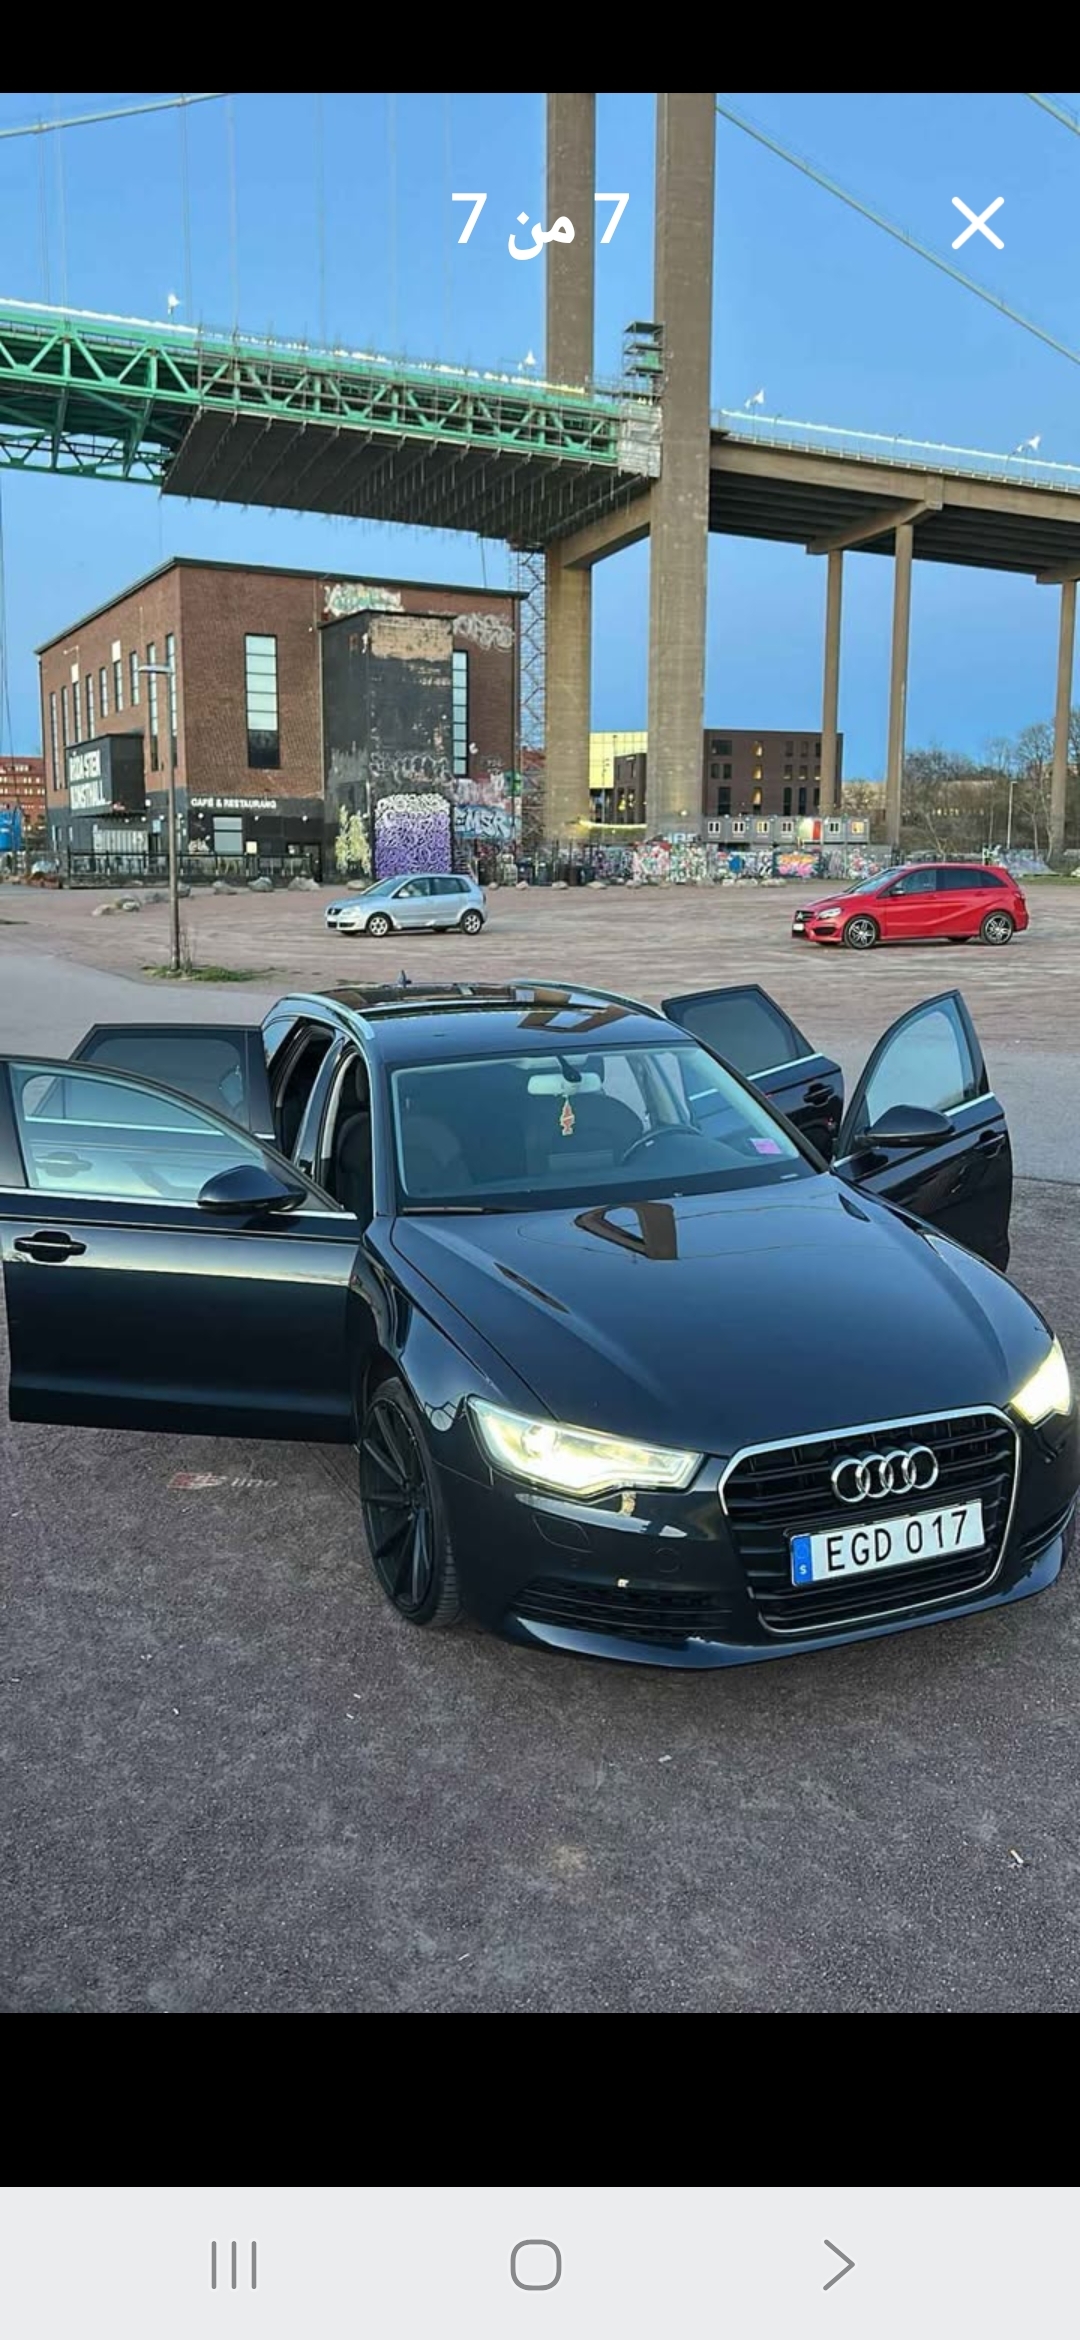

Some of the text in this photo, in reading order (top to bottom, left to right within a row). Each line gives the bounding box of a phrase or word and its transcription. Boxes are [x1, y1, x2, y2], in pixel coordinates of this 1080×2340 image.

[223, 798, 277, 810] RESTAURANG
[826, 1509, 968, 1572] EGD 017
[798, 1564, 808, 1576] S
